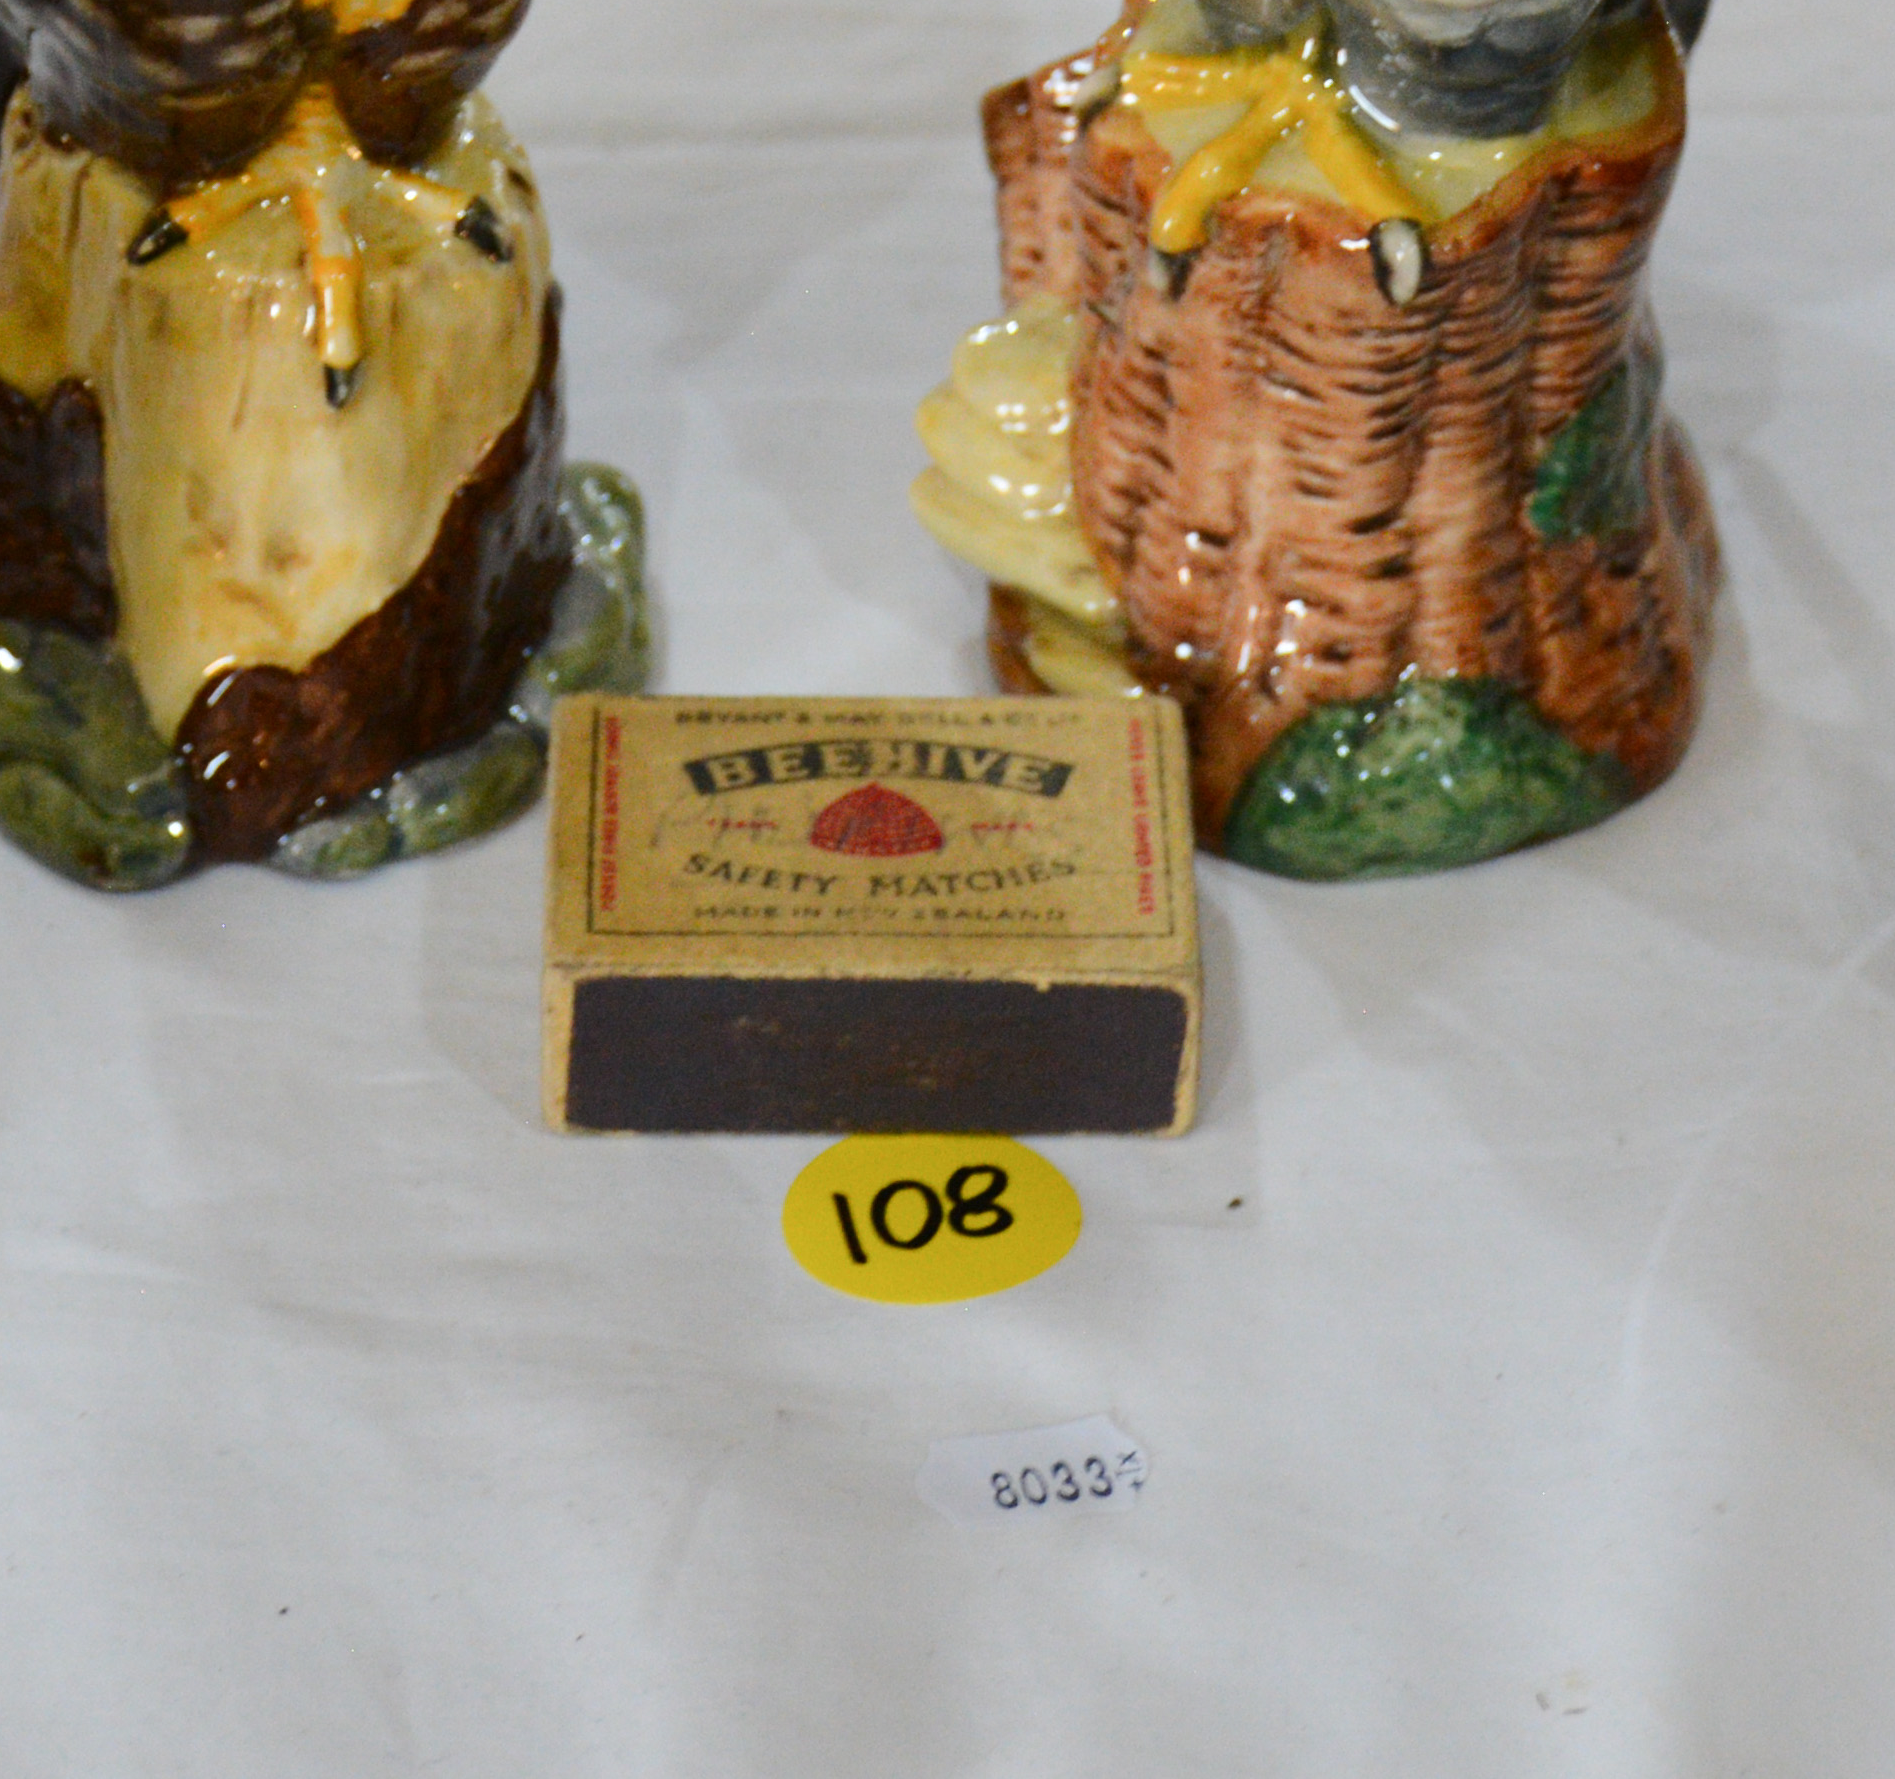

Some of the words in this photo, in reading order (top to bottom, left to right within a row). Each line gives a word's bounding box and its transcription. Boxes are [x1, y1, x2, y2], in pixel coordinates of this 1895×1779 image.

[706, 739, 1053, 794] BEEHIVE
[683, 853, 838, 896] SAFETY
[868, 859, 1077, 898] MATCHES
[831, 1163, 1014, 1266] 108
